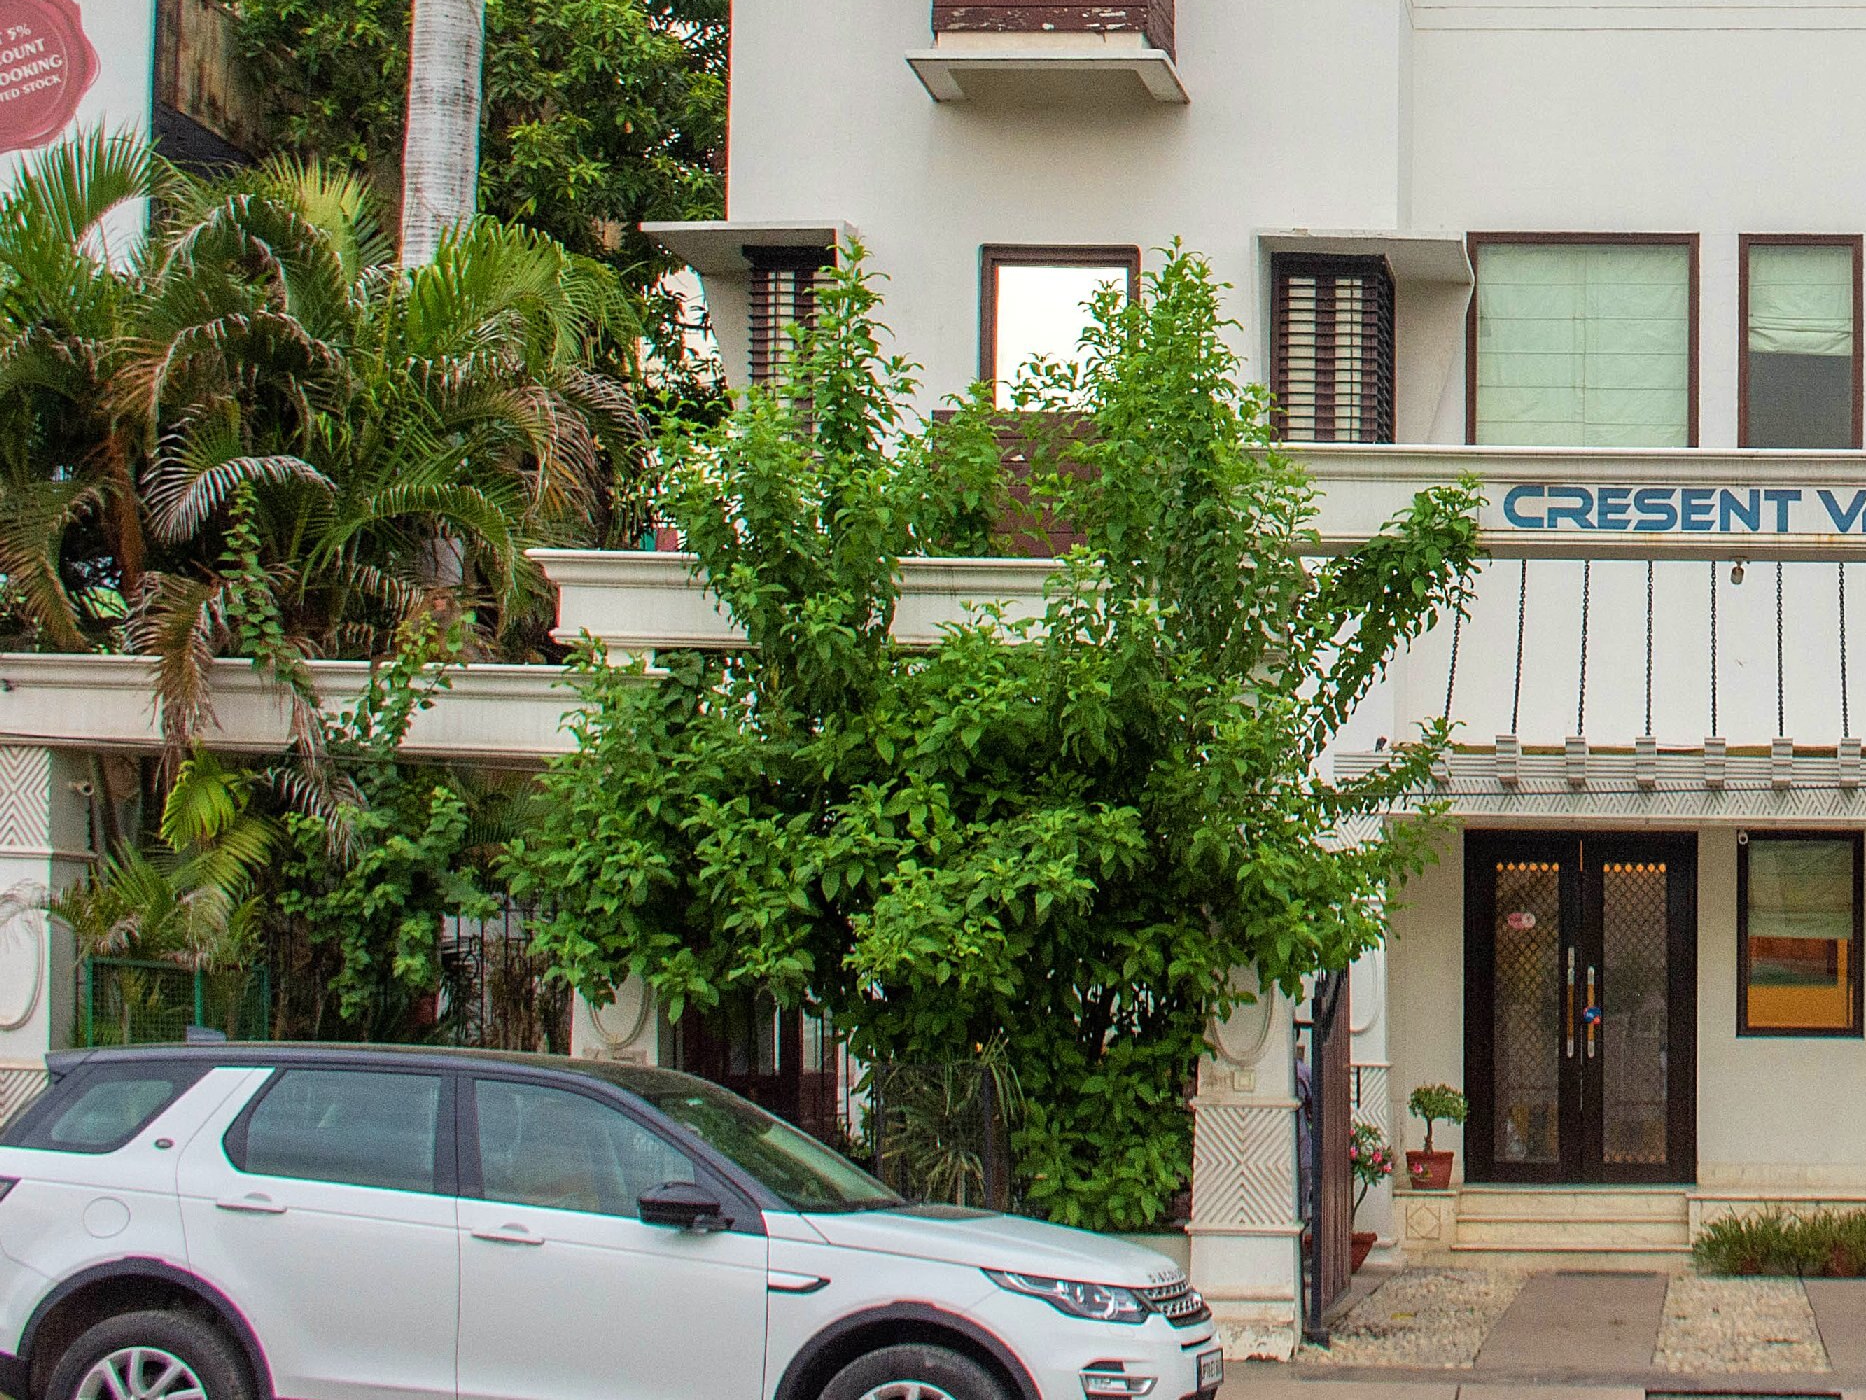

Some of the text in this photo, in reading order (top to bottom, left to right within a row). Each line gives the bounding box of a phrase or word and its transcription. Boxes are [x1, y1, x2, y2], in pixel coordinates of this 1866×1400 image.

[7, 24, 32, 41] 5%
[0, 38, 45, 64] OUNT
[0, 54, 63, 86] OOKING
[1503, 485, 1802, 532] CRESENT
